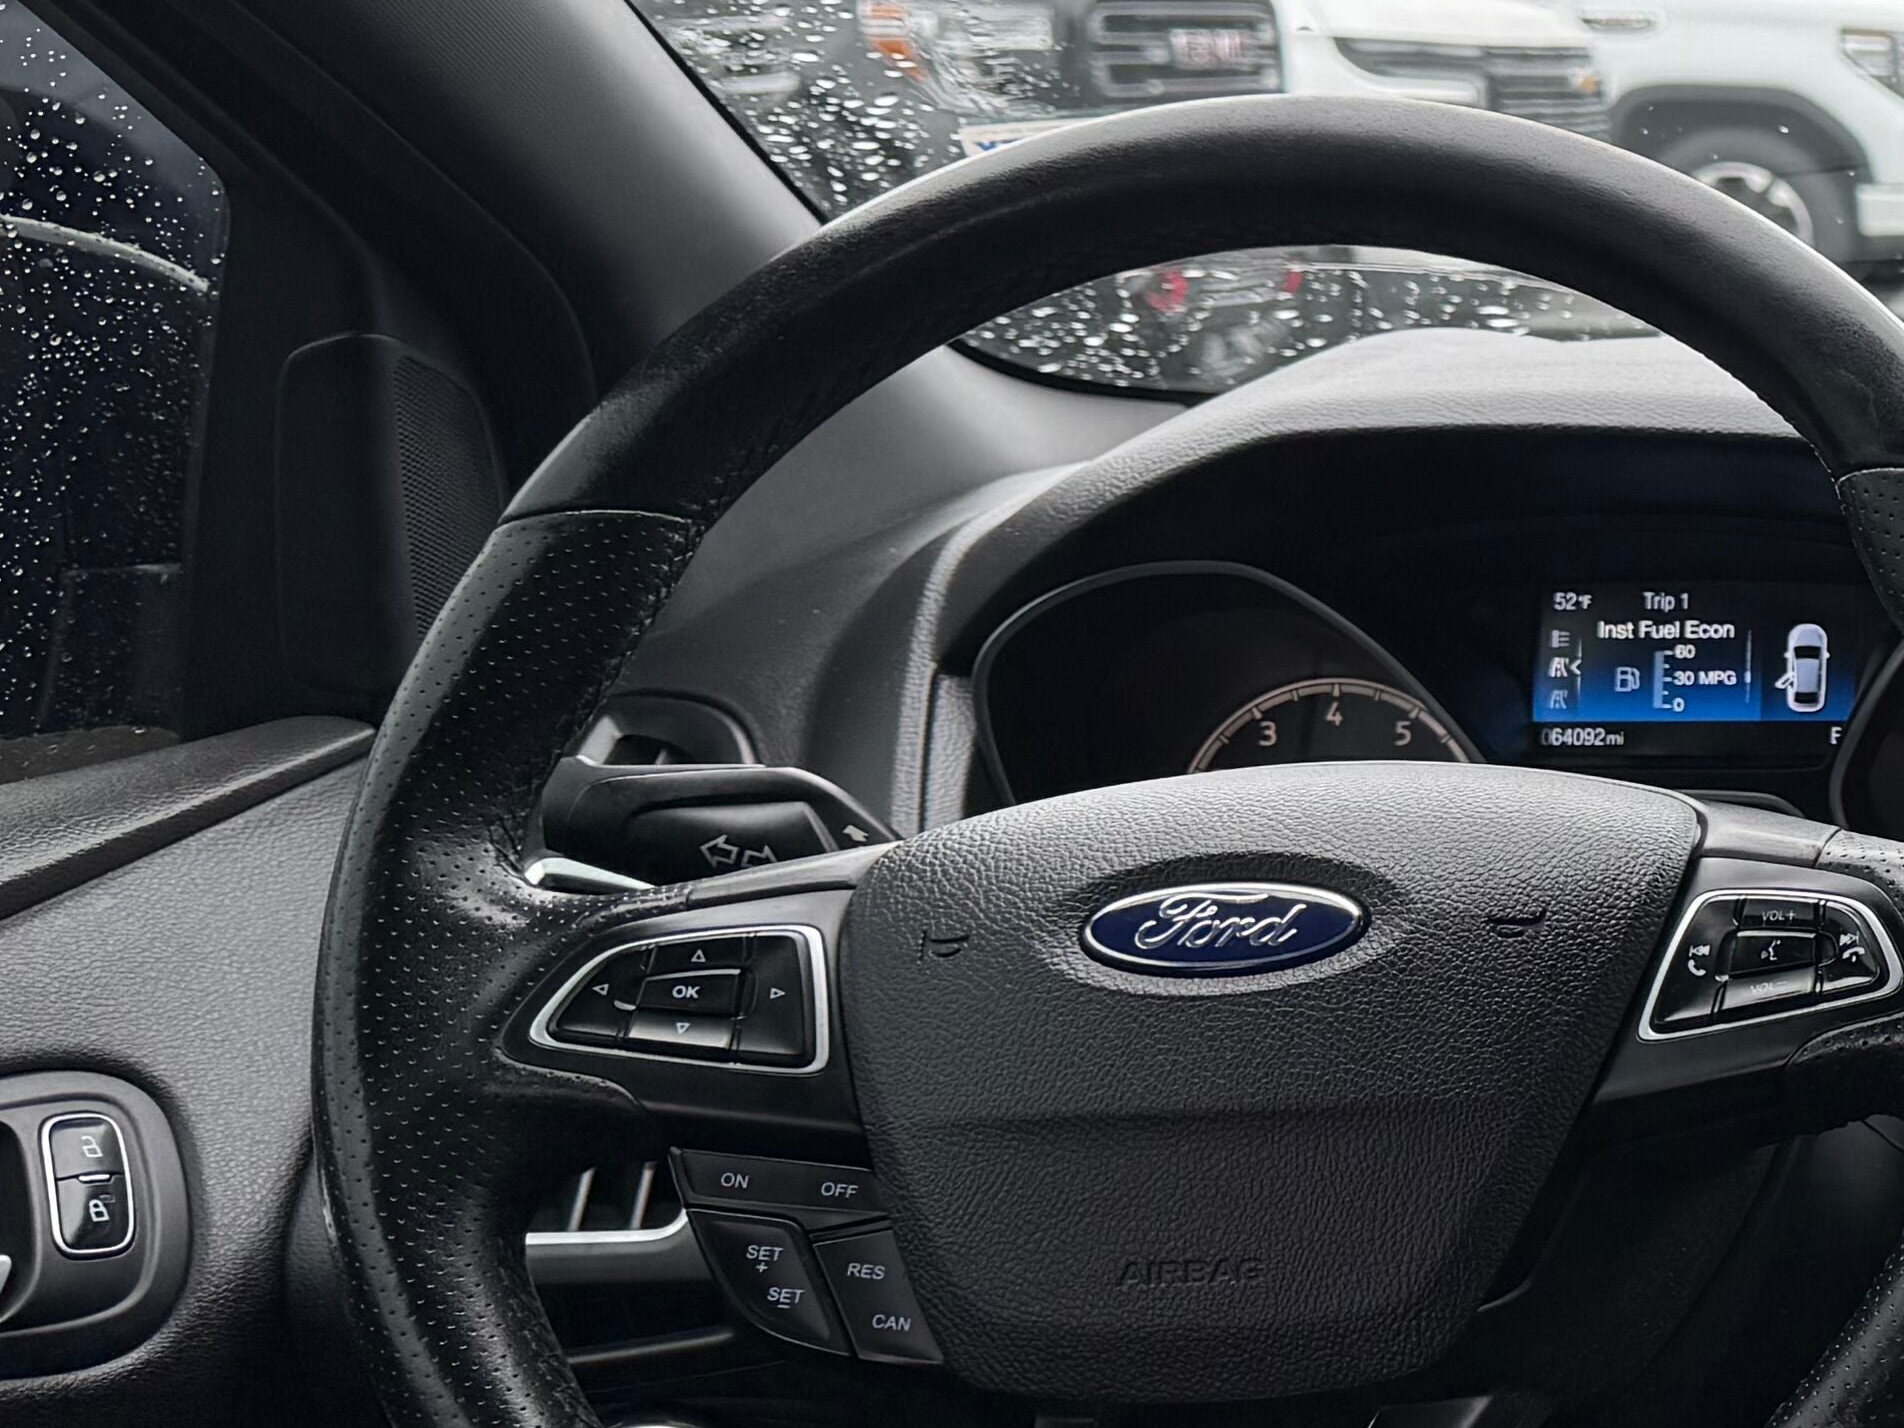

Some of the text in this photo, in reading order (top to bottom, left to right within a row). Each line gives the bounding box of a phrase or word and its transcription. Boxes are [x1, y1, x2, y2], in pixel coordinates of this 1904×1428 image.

[1553, 592, 1592, 611] 52°F
[1642, 591, 1689, 612] Trip 1
[1597, 620, 1735, 640] Inst Fuel Econ
[1674, 645, 1696, 659] 60
[1672, 671, 1736, 686] 30 MPG
[1324, 702, 1343, 727] 4
[1673, 699, 1685, 712] 0
[1257, 722, 1278, 747] 3
[1393, 721, 1413, 747] 5
[1135, 891, 1307, 952] Ford
[671, 984, 700, 999] OK
[720, 1172, 749, 1189] ON
[821, 1181, 858, 1199] OFF
[746, 1244, 784, 1262] SET
[847, 1262, 886, 1280] RES
[1116, 1257, 1264, 1290] AIRBAG
[766, 1286, 805, 1304] SET
[871, 1314, 912, 1332] CAN
